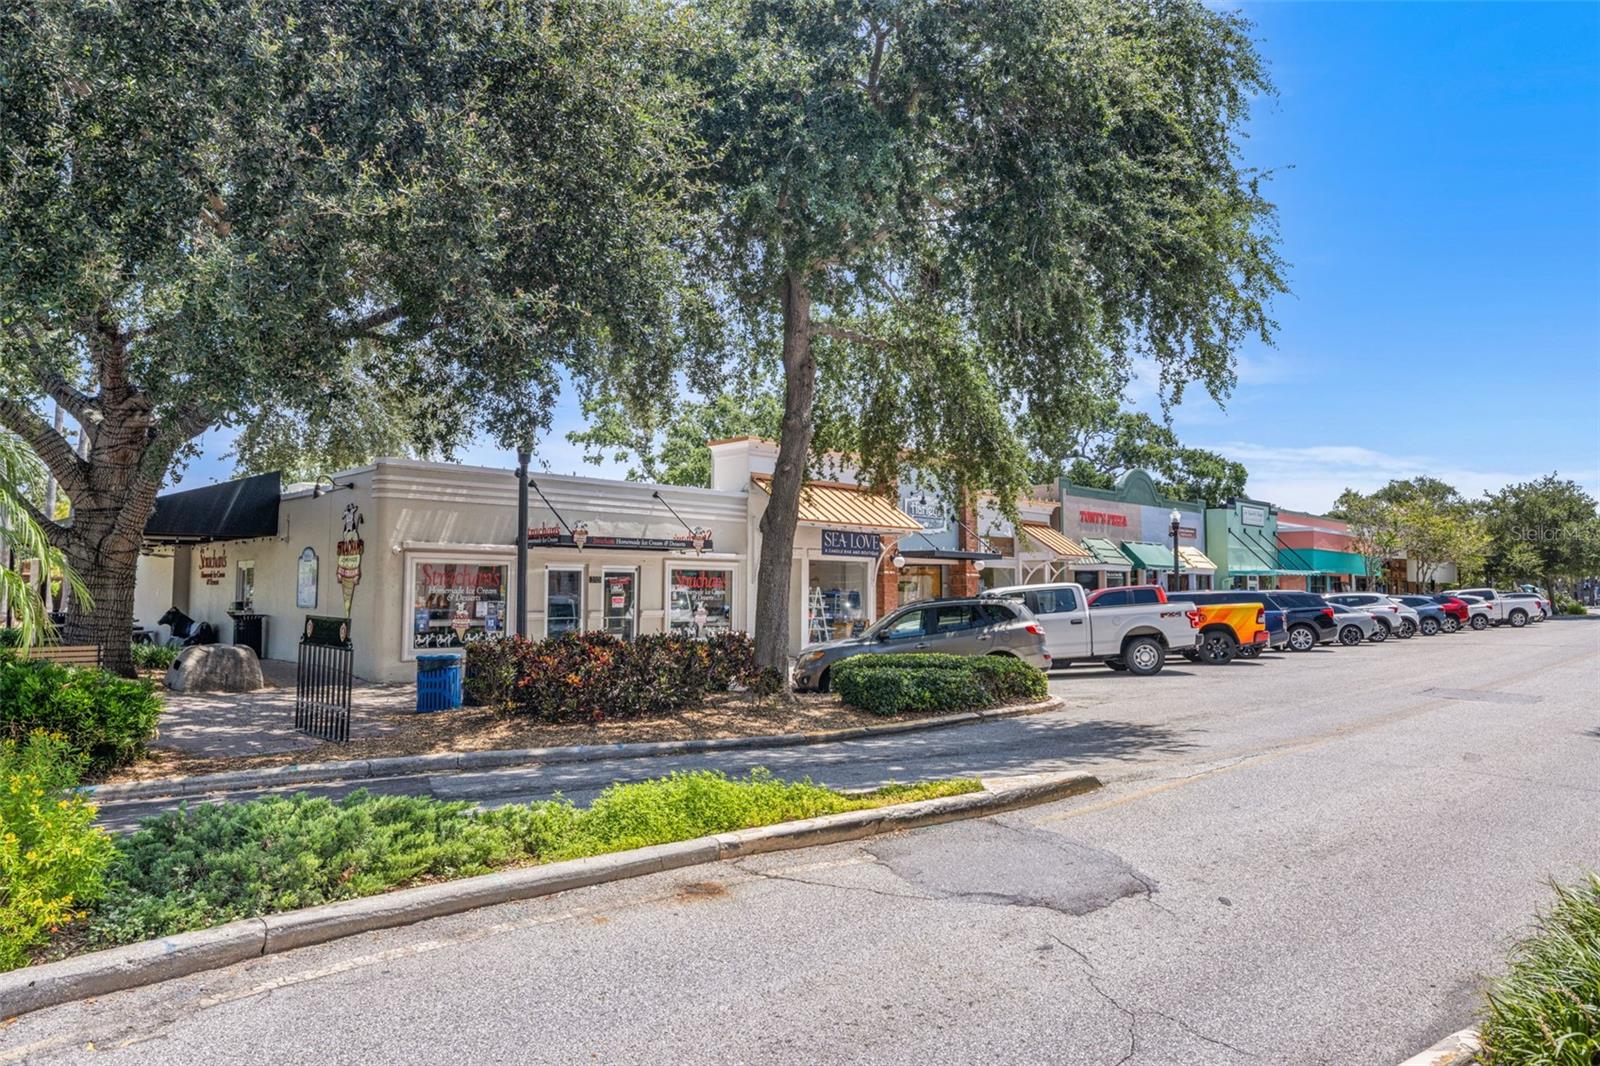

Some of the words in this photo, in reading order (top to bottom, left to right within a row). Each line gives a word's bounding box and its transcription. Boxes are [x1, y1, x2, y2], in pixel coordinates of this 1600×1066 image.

[616, 538, 640, 546] Homemade
[824, 532, 847, 548] SEA
[850, 533, 879, 550] LOVE
